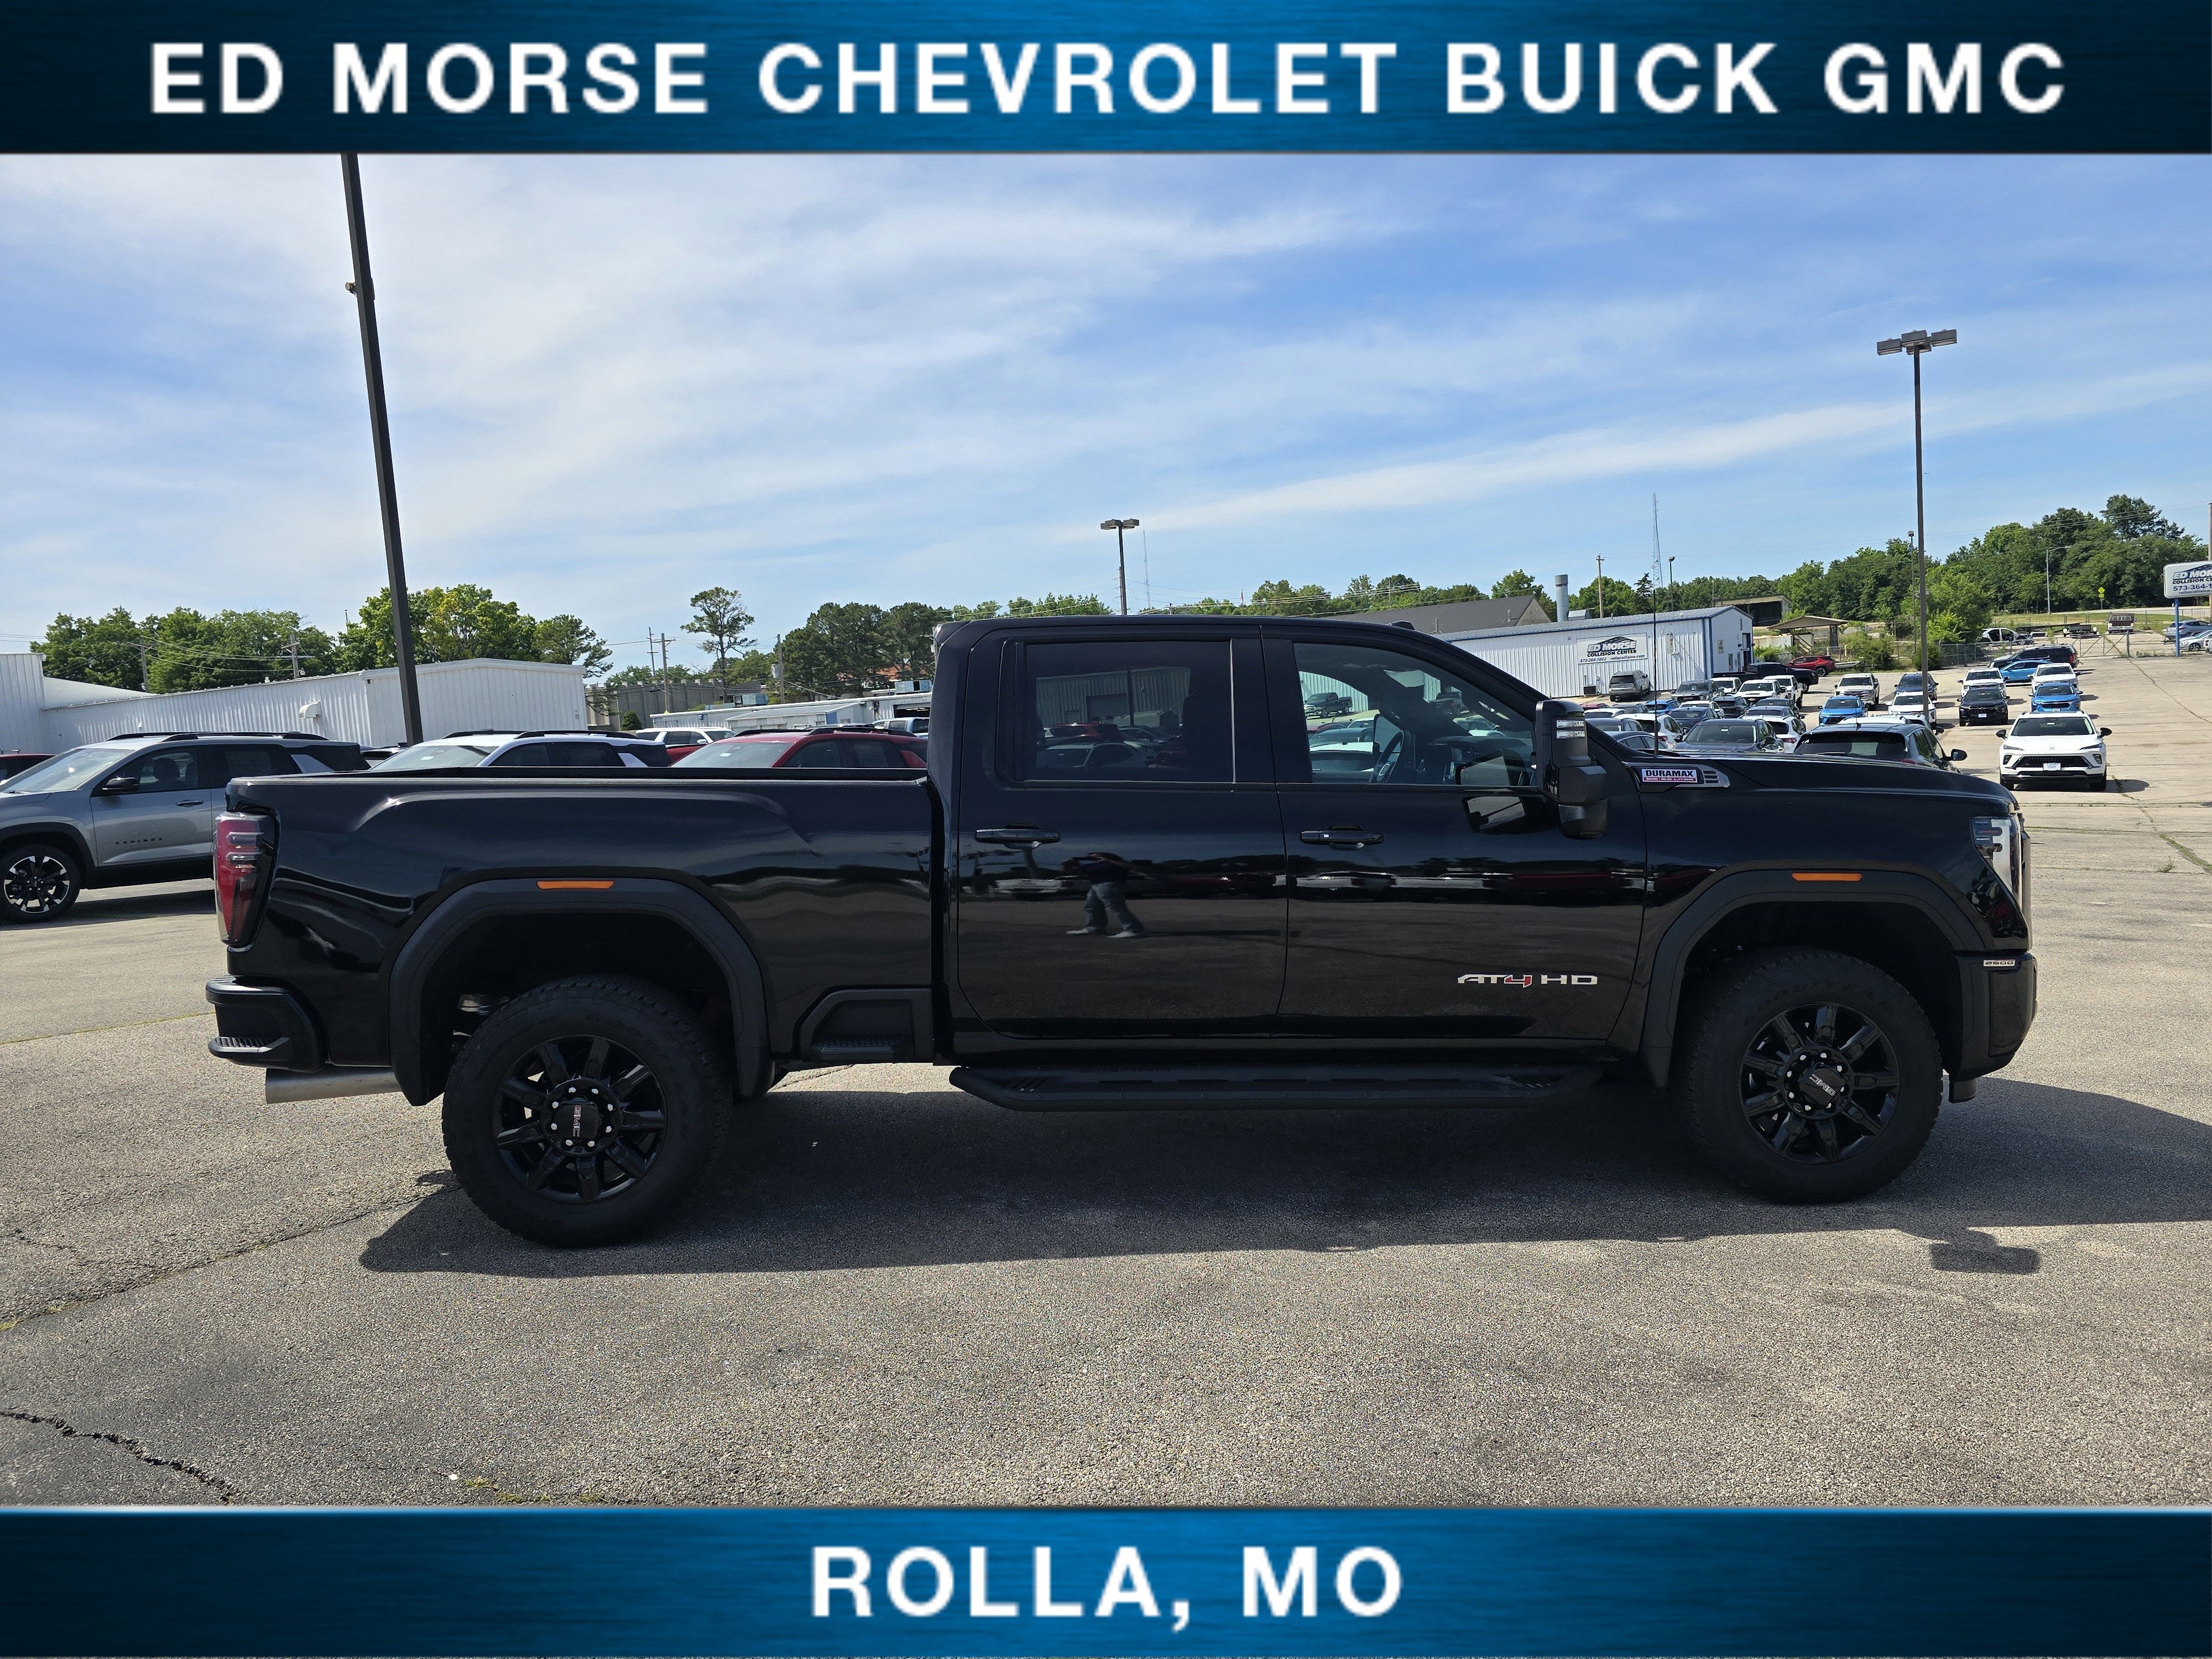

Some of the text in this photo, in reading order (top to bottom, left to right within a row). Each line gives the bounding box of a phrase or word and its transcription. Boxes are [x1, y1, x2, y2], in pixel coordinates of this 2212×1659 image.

[1602, 641, 1636, 651] MORSE
[1457, 974, 1598, 988] AT4 HD
[1809, 1073, 1836, 1097] GMC
[572, 1105, 582, 1138] GMC
